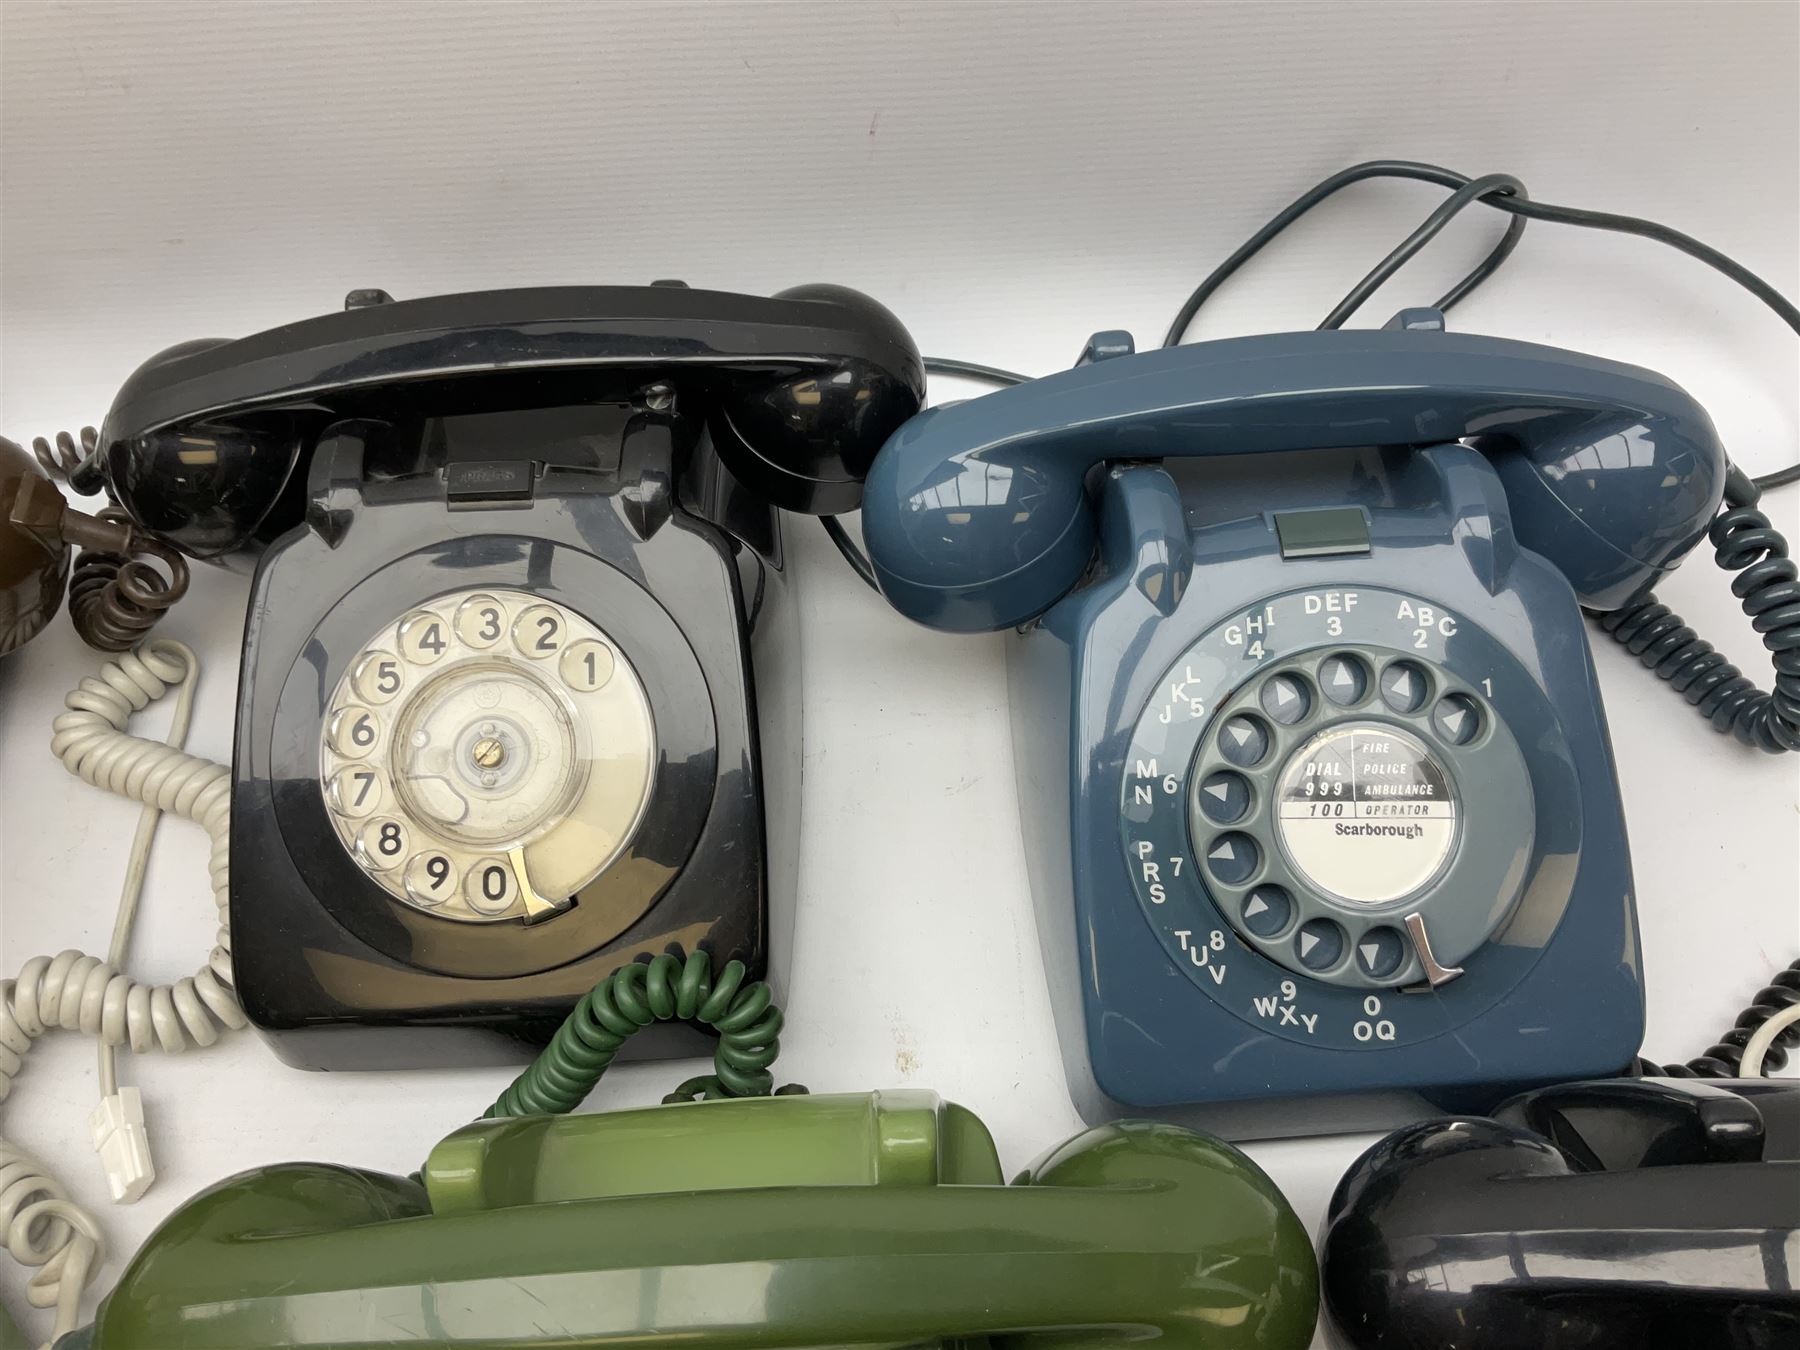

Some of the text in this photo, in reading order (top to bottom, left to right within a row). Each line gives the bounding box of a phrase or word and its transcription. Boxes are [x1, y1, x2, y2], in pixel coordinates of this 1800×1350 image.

[1304, 592, 1358, 615] DEF
[479, 608, 501, 641] 3
[1224, 606, 1275, 646] GHI
[1327, 616, 1343, 637] 3
[1396, 600, 1458, 637] ABC
[418, 623, 446, 655] 4
[535, 616, 558, 651] 2
[1412, 629, 1428, 649] 2
[1248, 640, 1265, 660] 4
[377, 661, 401, 694] 5
[583, 652, 596, 685] 1
[1481, 677, 1492, 698] 1
[1190, 698, 1204, 718] 5
[351, 713, 375, 746] 6
[1362, 743, 1390, 753] FIRE
[1306, 762, 1342, 777] DIAL
[1363, 763, 1407, 775] POLICE
[353, 772, 376, 807] 7
[1162, 774, 1178, 794] 6
[1305, 782, 1343, 797] 999
[1364, 784, 1434, 796] AMBULANCE
[1310, 803, 1344, 817] 100
[1366, 805, 1429, 816] OPERATOR
[378, 822, 401, 856] 8
[1335, 823, 1424, 840] Scarborough
[426, 856, 450, 891] 9
[1169, 857, 1184, 877] 7
[482, 866, 507, 901] 0
[1210, 930, 1226, 951] 8
[1280, 980, 1297, 1001] 9
[1253, 996, 1319, 1034] WXY
[1353, 1020, 1396, 1042] OQ
